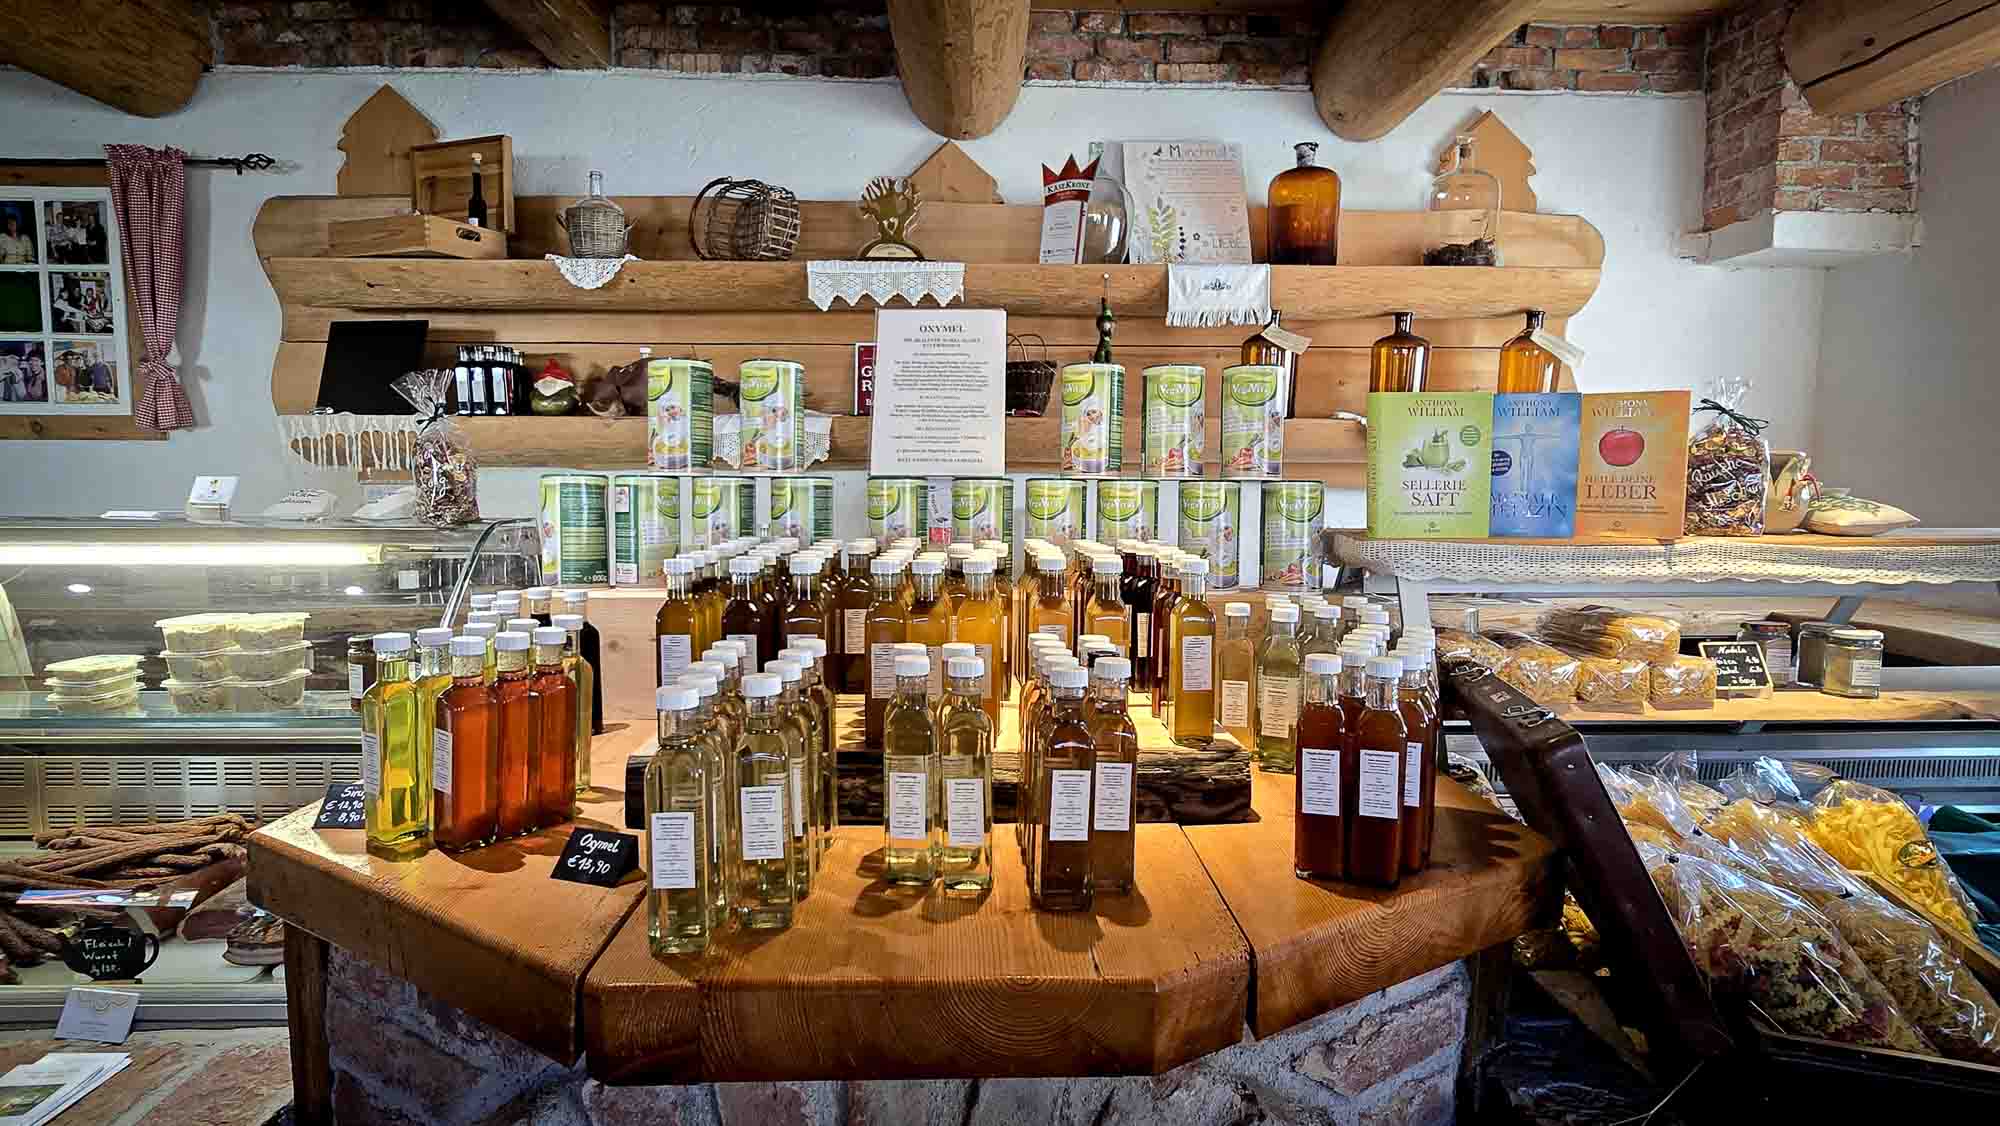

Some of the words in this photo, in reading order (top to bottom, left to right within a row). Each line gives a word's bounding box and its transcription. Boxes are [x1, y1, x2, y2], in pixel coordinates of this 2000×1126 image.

[919, 325, 967, 334] OXYMEL
[1408, 407, 1464, 417] WILLIAM
[1497, 407, 1560, 417] WILLIAM
[1402, 480, 1467, 491] SELLERIE
[1586, 485, 1657, 500] LEBER
[1411, 492, 1460, 507] SAFT
[341, 786, 366, 800] Siru
[580, 833, 621, 855] Oxymel
